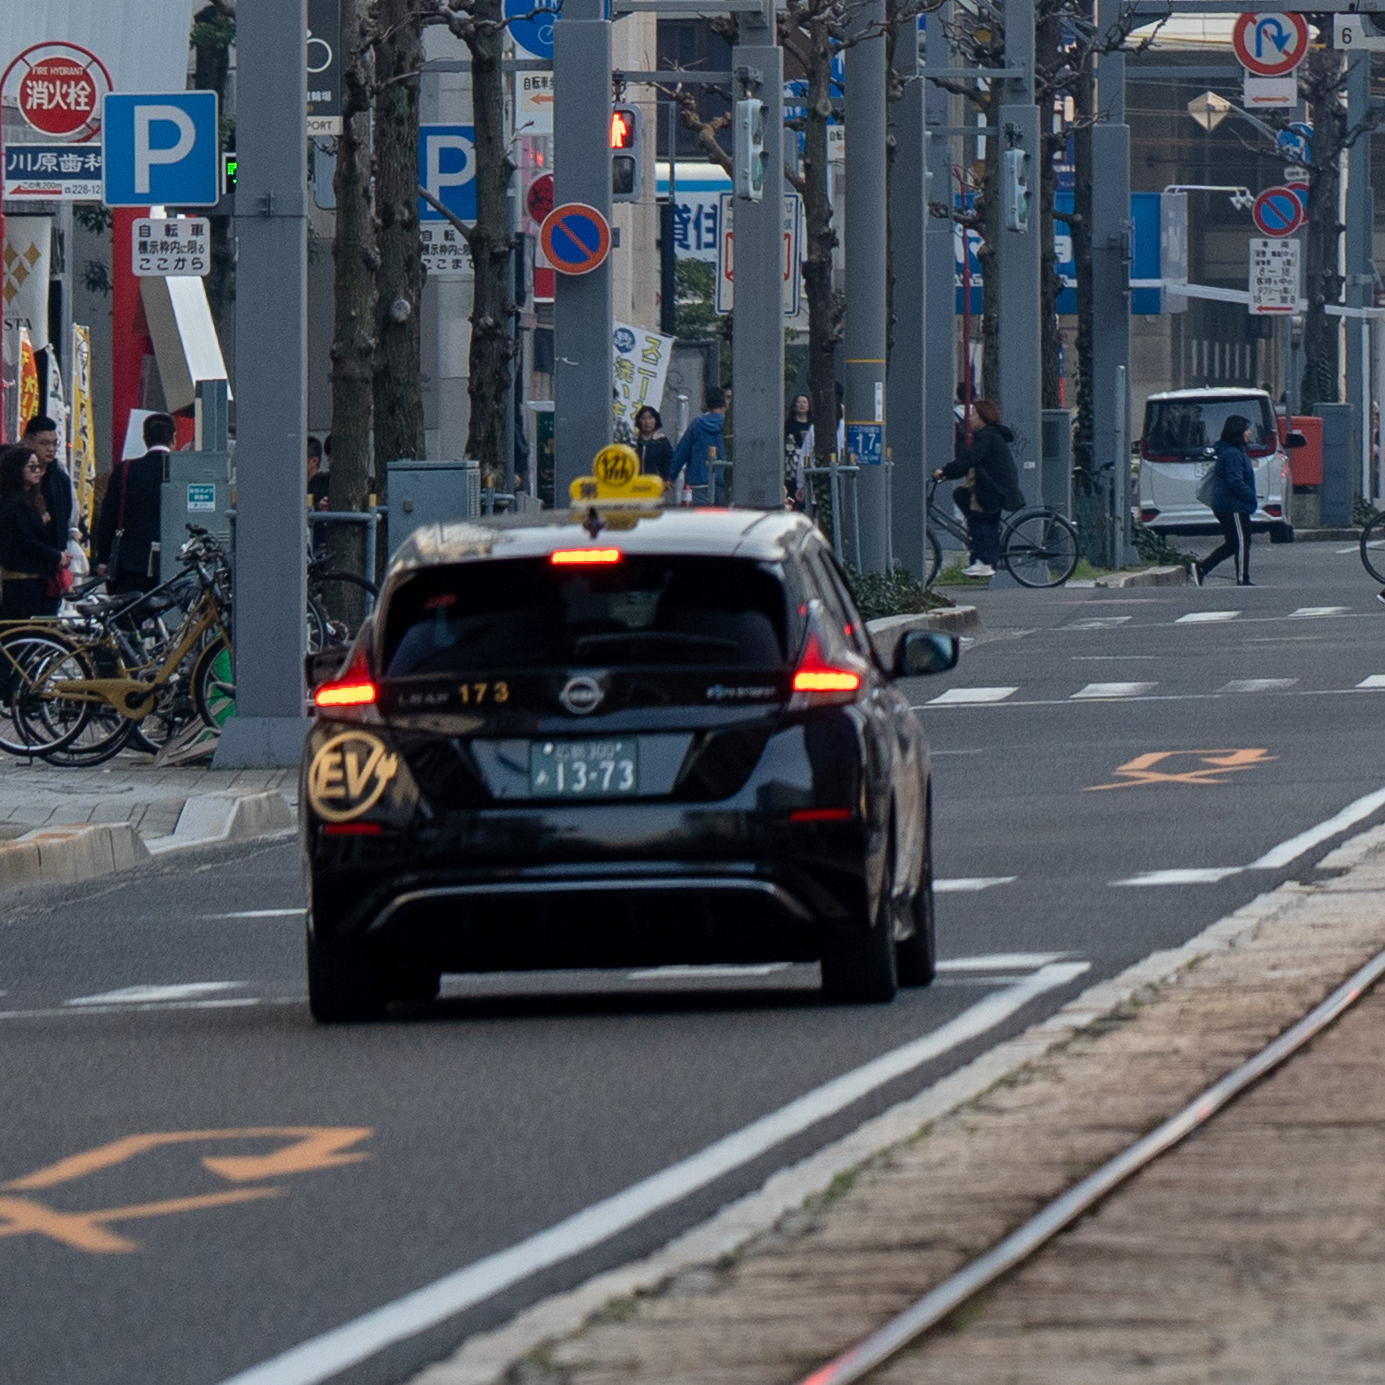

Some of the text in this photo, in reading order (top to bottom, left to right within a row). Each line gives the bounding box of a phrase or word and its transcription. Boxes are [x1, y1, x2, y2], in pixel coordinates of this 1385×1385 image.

[32, 66, 85, 76] FIRE HYDRANT
[25, 79, 93, 112] 消火栓
[134, 105, 196, 195] P
[427, 134, 477, 212] P
[138, 223, 205, 238] 自転車
[137, 240, 206, 255] 標示枠内に限る
[138, 257, 205, 271] ここから
[459, 682, 509, 704] 173
[316, 745, 380, 800] EV
[556, 760, 635, 792] 13-73
